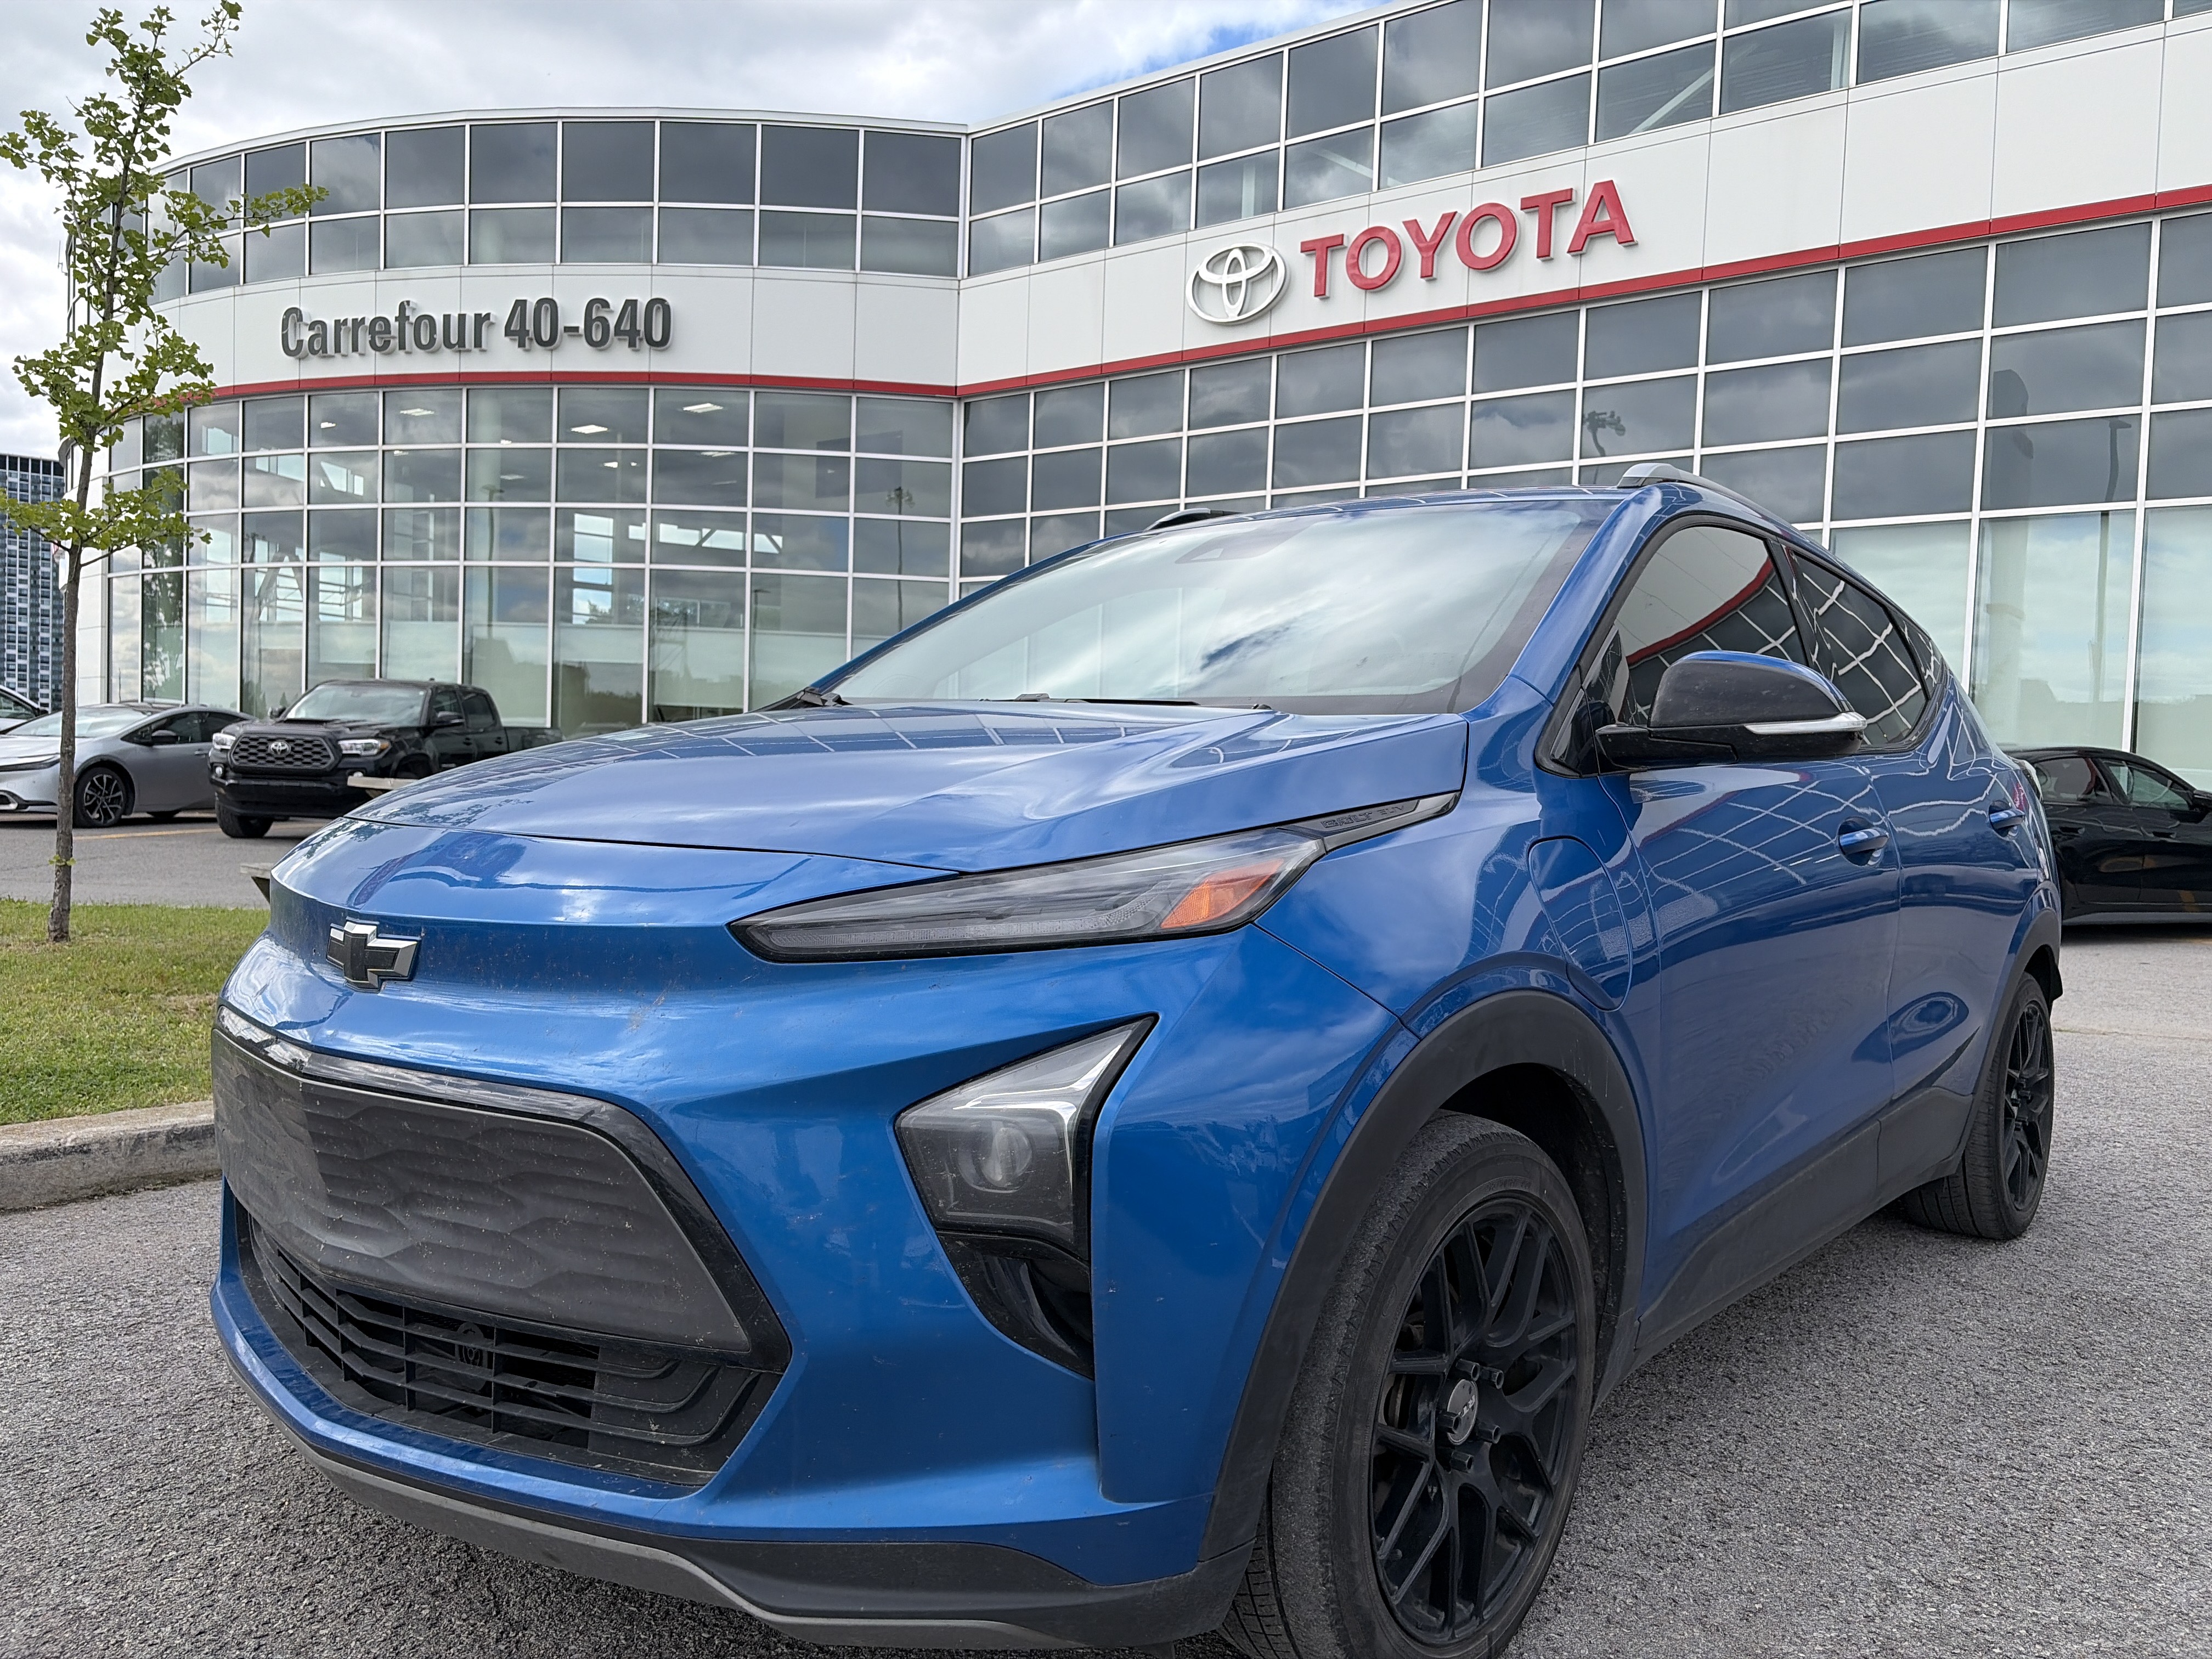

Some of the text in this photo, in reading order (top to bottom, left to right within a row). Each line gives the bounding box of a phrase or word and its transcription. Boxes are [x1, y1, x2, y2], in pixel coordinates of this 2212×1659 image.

[1300, 180, 1635, 300] TOYOTA
[281, 298, 673, 357] Carrefour 40-640
[1321, 805, 1404, 828] BOLT EUV
